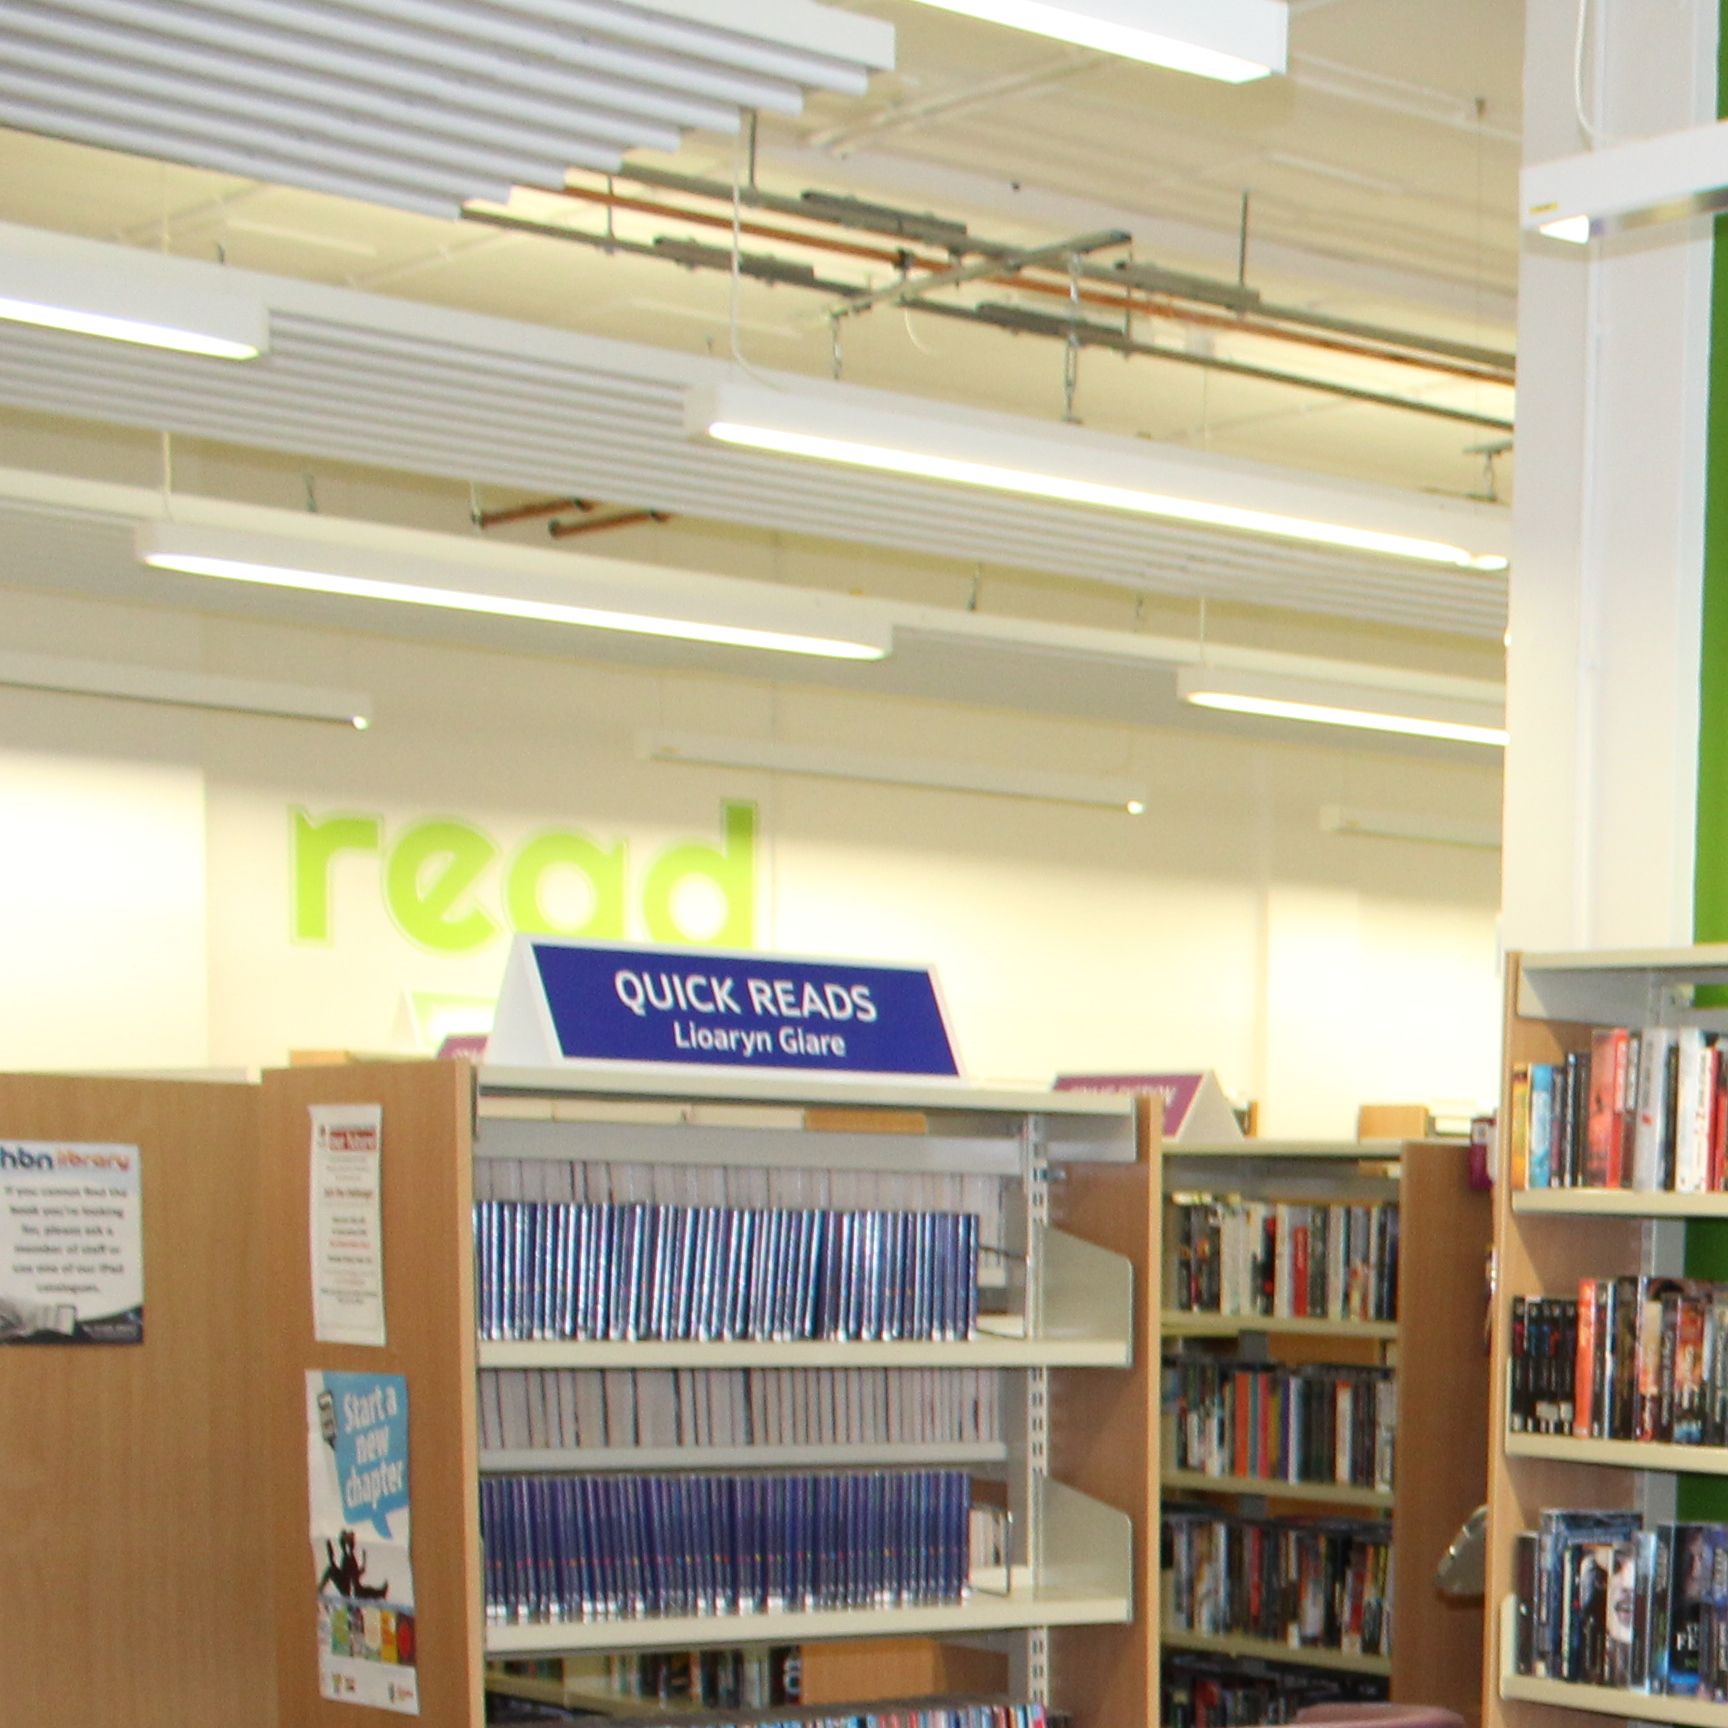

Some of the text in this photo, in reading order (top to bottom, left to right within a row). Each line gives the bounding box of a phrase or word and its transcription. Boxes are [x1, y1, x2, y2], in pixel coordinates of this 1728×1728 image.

[288, 799, 759, 953] read
[614, 969, 878, 1023] QUICK READS
[673, 1020, 847, 1058] Lioaryn Glare
[343, 1385, 398, 1432] Start a
[355, 1426, 390, 1465] new
[345, 1456, 404, 1510] chapter
